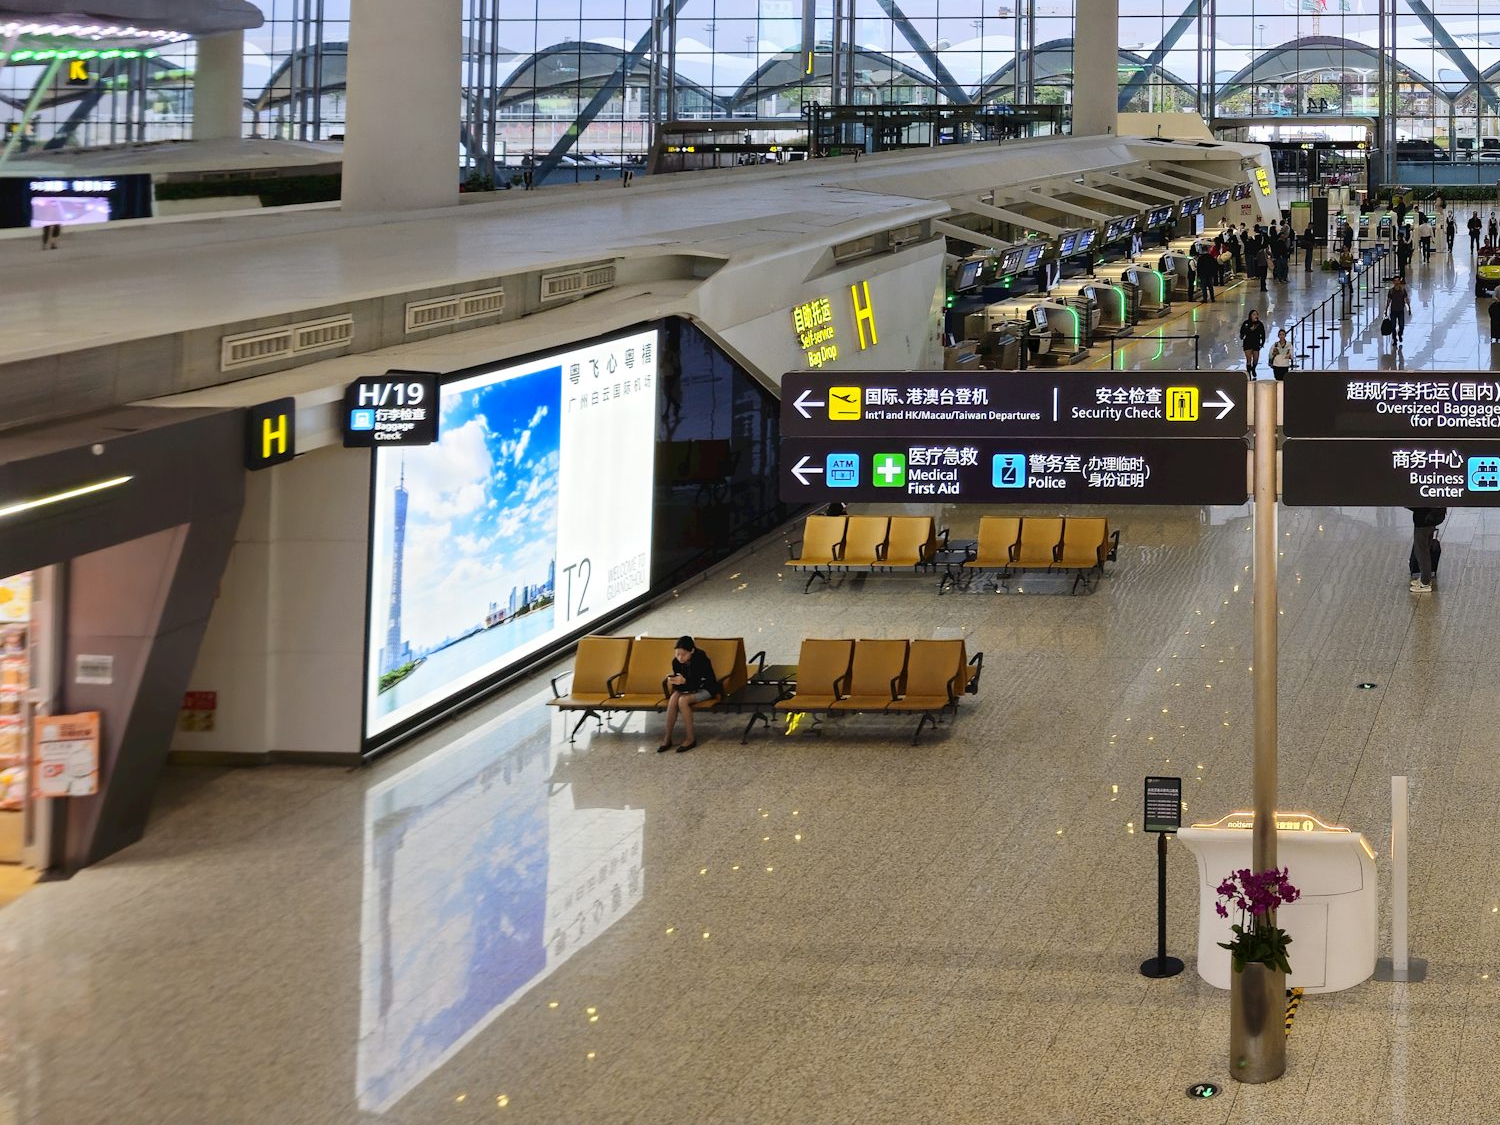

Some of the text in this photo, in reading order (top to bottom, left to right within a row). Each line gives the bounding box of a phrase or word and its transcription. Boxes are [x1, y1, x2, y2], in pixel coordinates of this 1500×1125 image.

[69, 60, 88, 79] K
[806, 51, 813, 75] J
[793, 298, 832, 333] 自助托运
[851, 280, 878, 350] H
[800, 325, 834, 350] Self-service
[808, 345, 837, 368] Bag Drop
[359, 383, 425, 407] H/19
[865, 387, 989, 406] 国际、港澳台登机
[1095, 387, 1163, 405] 安全检查
[375, 408, 426, 422] 行李检查
[886, 410, 903, 421] and
[905, 410, 987, 422] HK/Macau/Taiwan
[988, 411, 1041, 422] Departures
[1072, 406, 1162, 421] Security Check
[1376, 401, 1437, 415] Oversized
[374, 422, 414, 432] Baggage
[1410, 415, 1434, 428] (for
[262, 415, 287, 458] H
[374, 432, 402, 441] Check
[832, 460, 854, 468] ATM
[908, 447, 978, 466] 医疗急救
[1029, 453, 1081, 473] 警务室
[1391, 450, 1464, 470] 商务中心
[909, 469, 958, 481] Medical
[1028, 476, 1066, 489] Police
[1410, 472, 1464, 485] Business
[908, 482, 960, 494] First Aid
[1420, 485, 1464, 498] Center
[563, 557, 592, 621] T2
